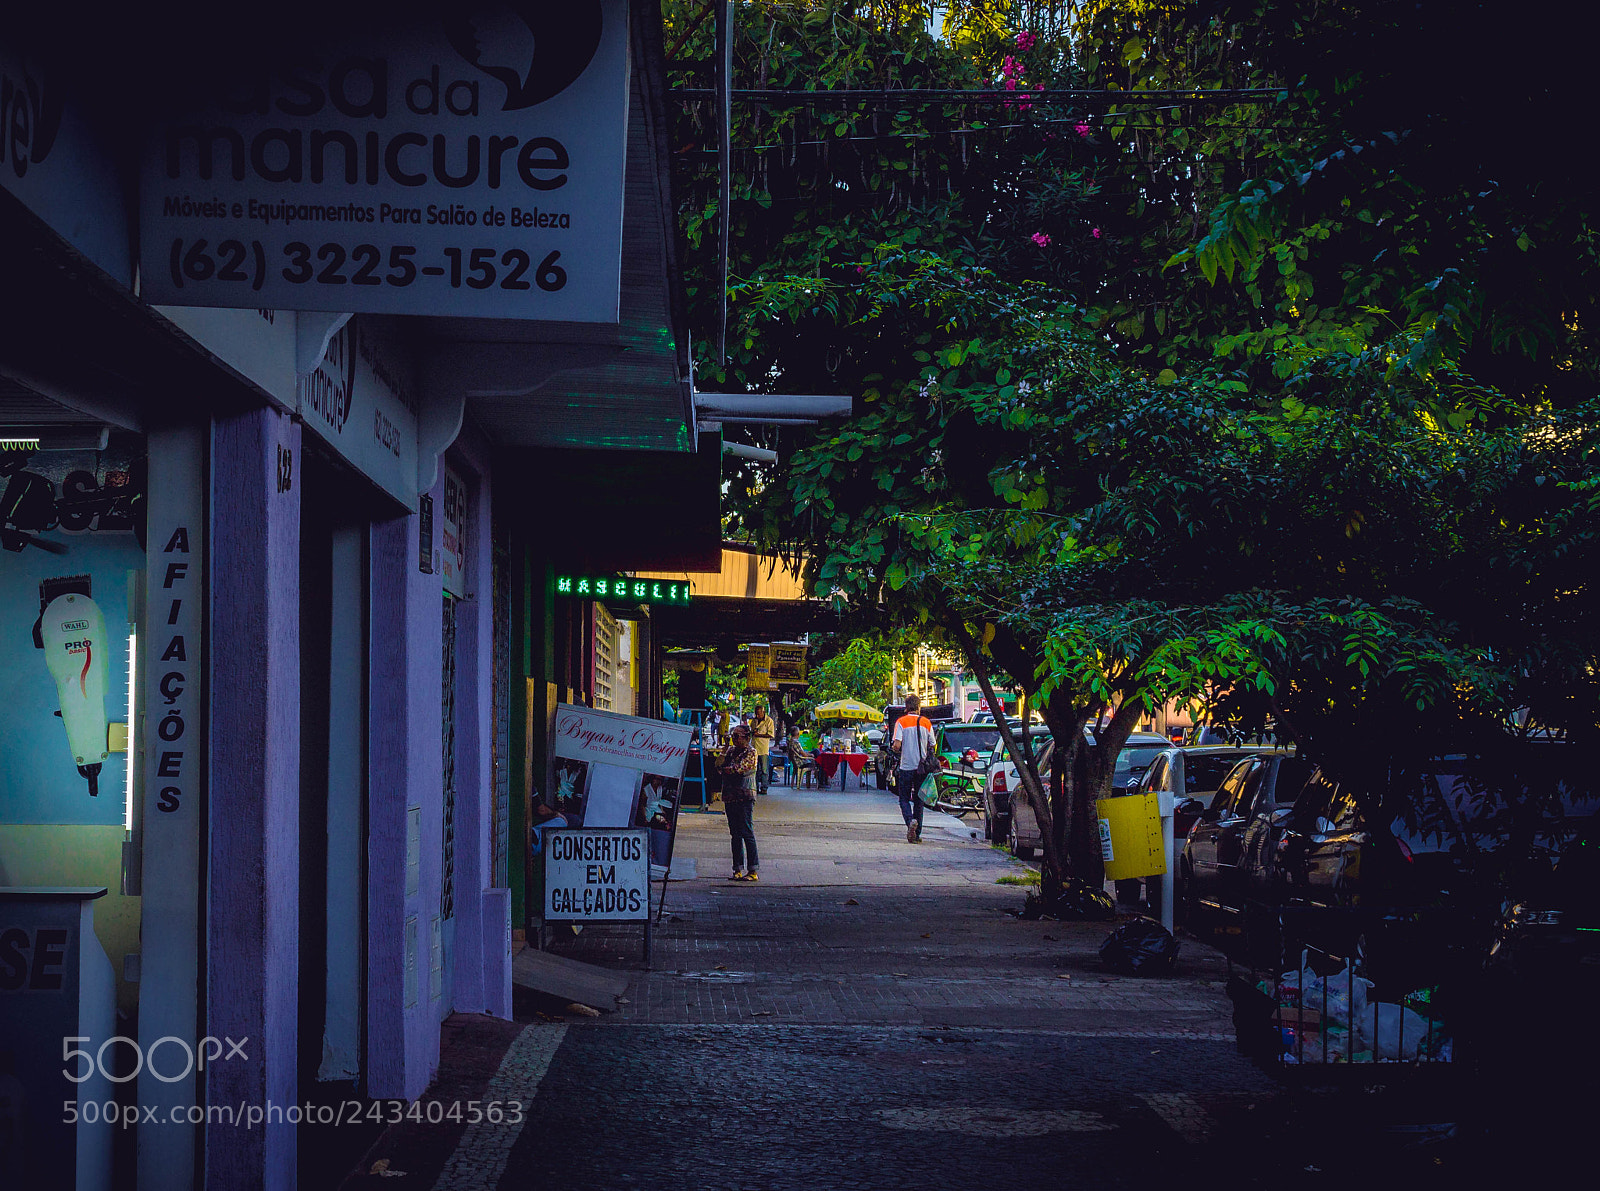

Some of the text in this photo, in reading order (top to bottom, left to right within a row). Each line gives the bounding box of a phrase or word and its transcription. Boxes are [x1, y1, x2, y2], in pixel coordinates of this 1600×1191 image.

[195, 55, 479, 119] asa da
[165, 123, 570, 191] manicure
[163, 196, 571, 229] Móveis e Equipamentos Para Salão de Beleza
[170, 238, 568, 292] (62) 3225-1526
[64, 622, 87, 630] WAHL
[64, 639, 92, 650] PRO
[157, 527, 190, 813] AFIAÇÕES
[558, 715, 685, 764] Bryan's Design
[552, 835, 641, 861] CONSERTOS
[586, 864, 616, 884] EM
[552, 888, 641, 916] CALÇADOS
